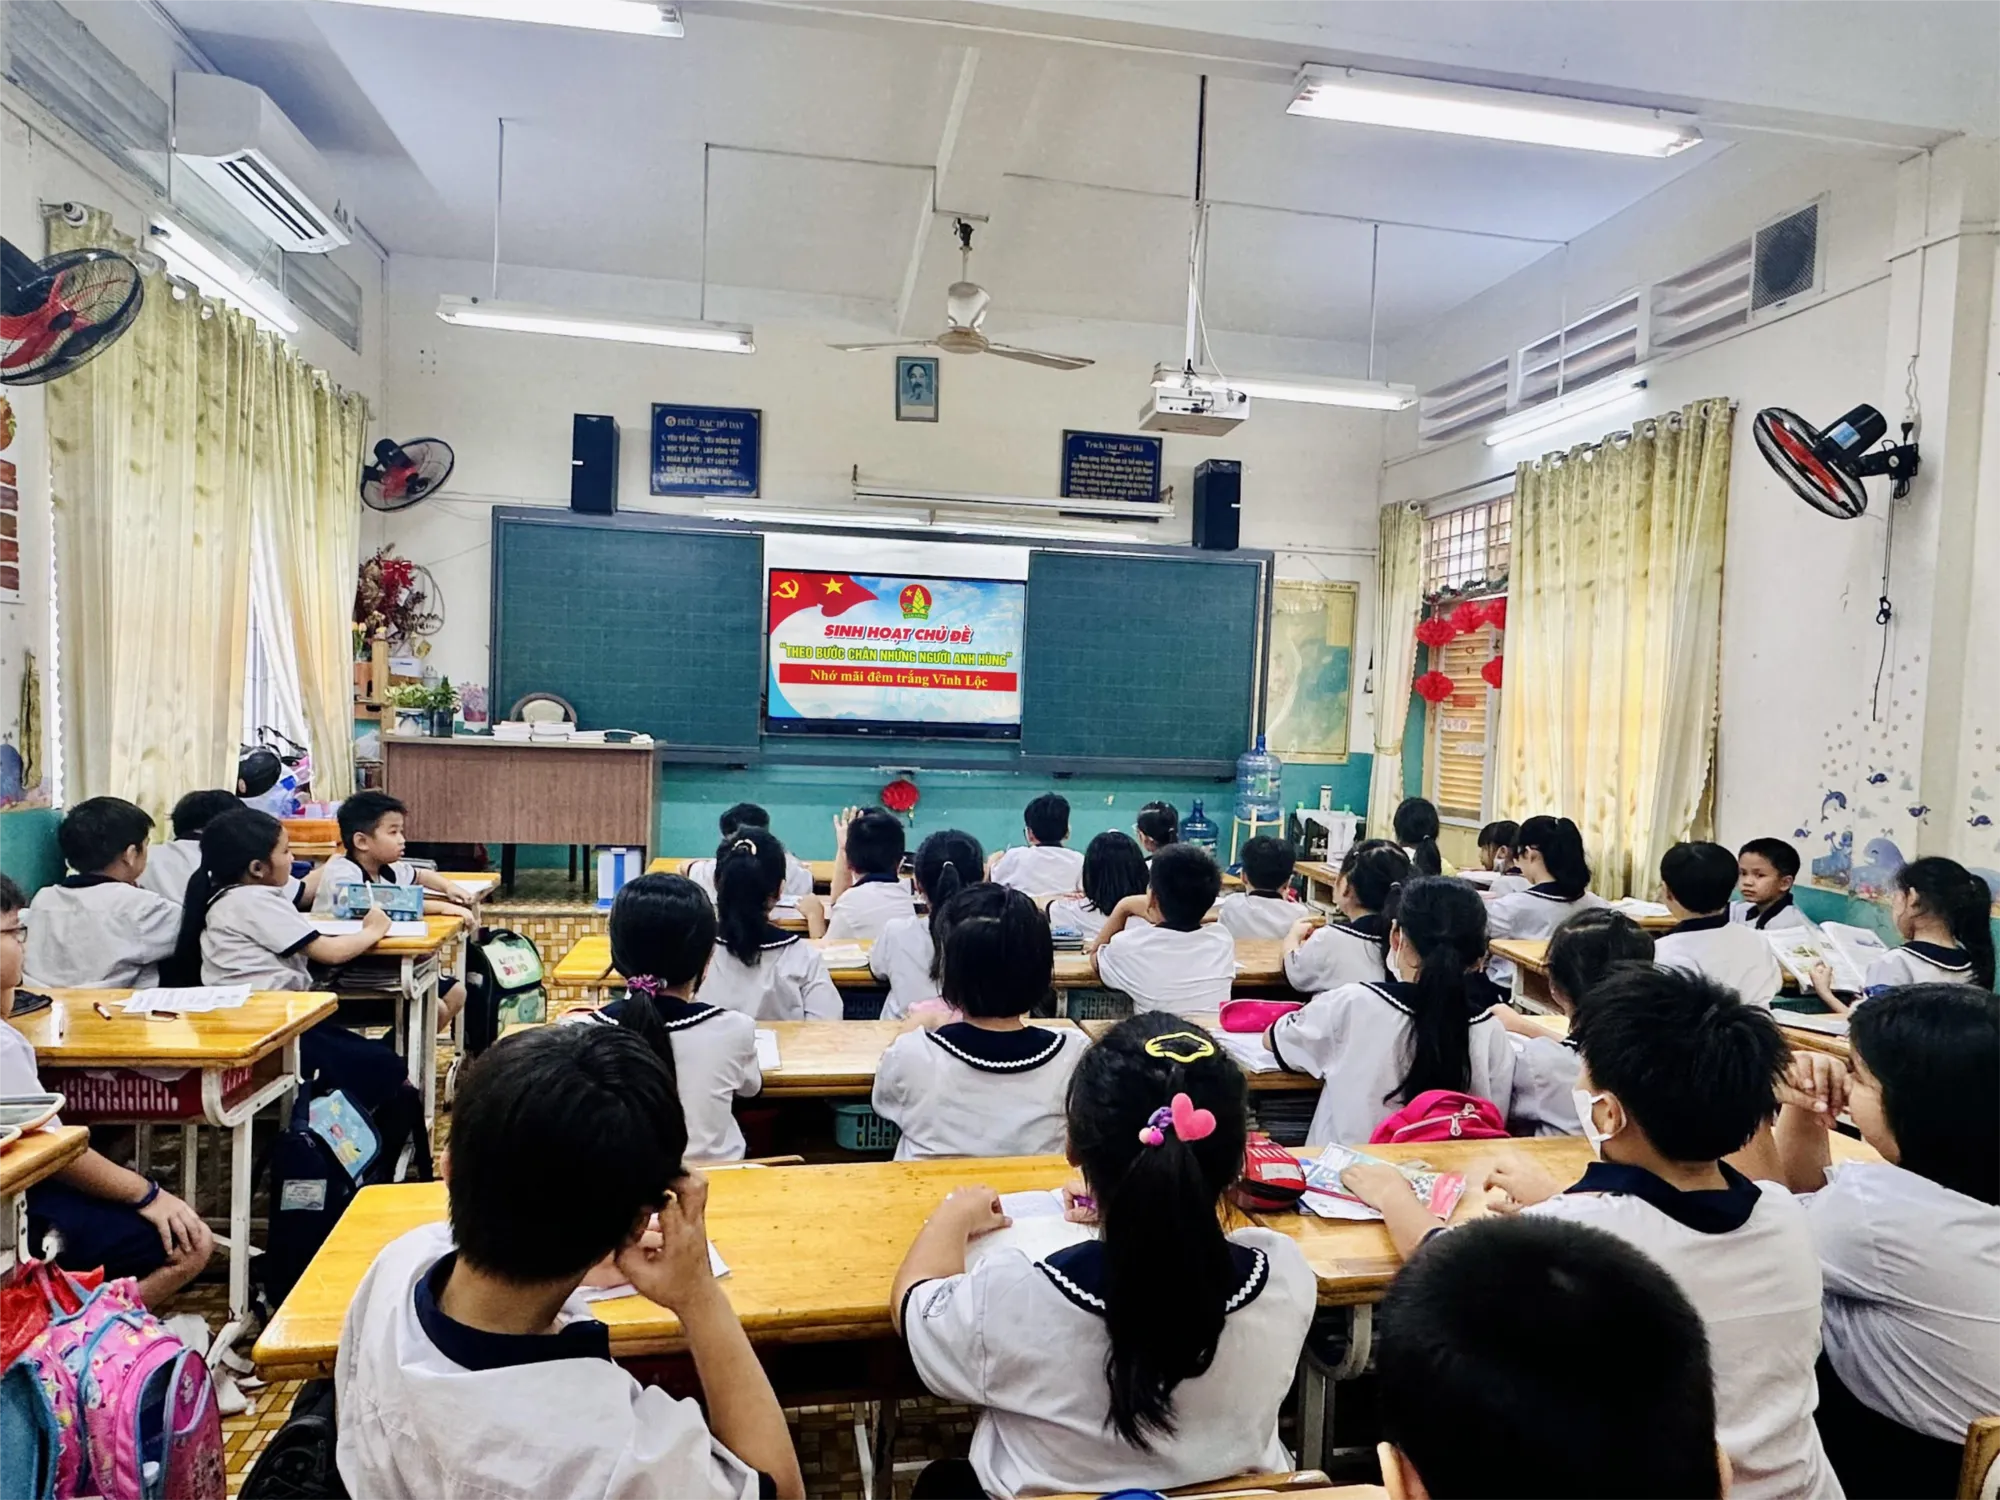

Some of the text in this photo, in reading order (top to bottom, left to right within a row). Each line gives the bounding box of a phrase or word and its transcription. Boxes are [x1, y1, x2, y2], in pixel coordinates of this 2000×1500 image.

[823, 624, 973, 643] SINH HOẠT CHỦ ĐỀ
[815, 644, 846, 660] BƯỚC
[847, 646, 878, 661] CHÂN
[879, 647, 916, 664] NHỮNG
[918, 649, 951, 664] NGƯỜI
[953, 652, 976, 665] ANH
[810, 669, 989, 689] Nhớ mãi đêm trắng Vĩnh Lộc
